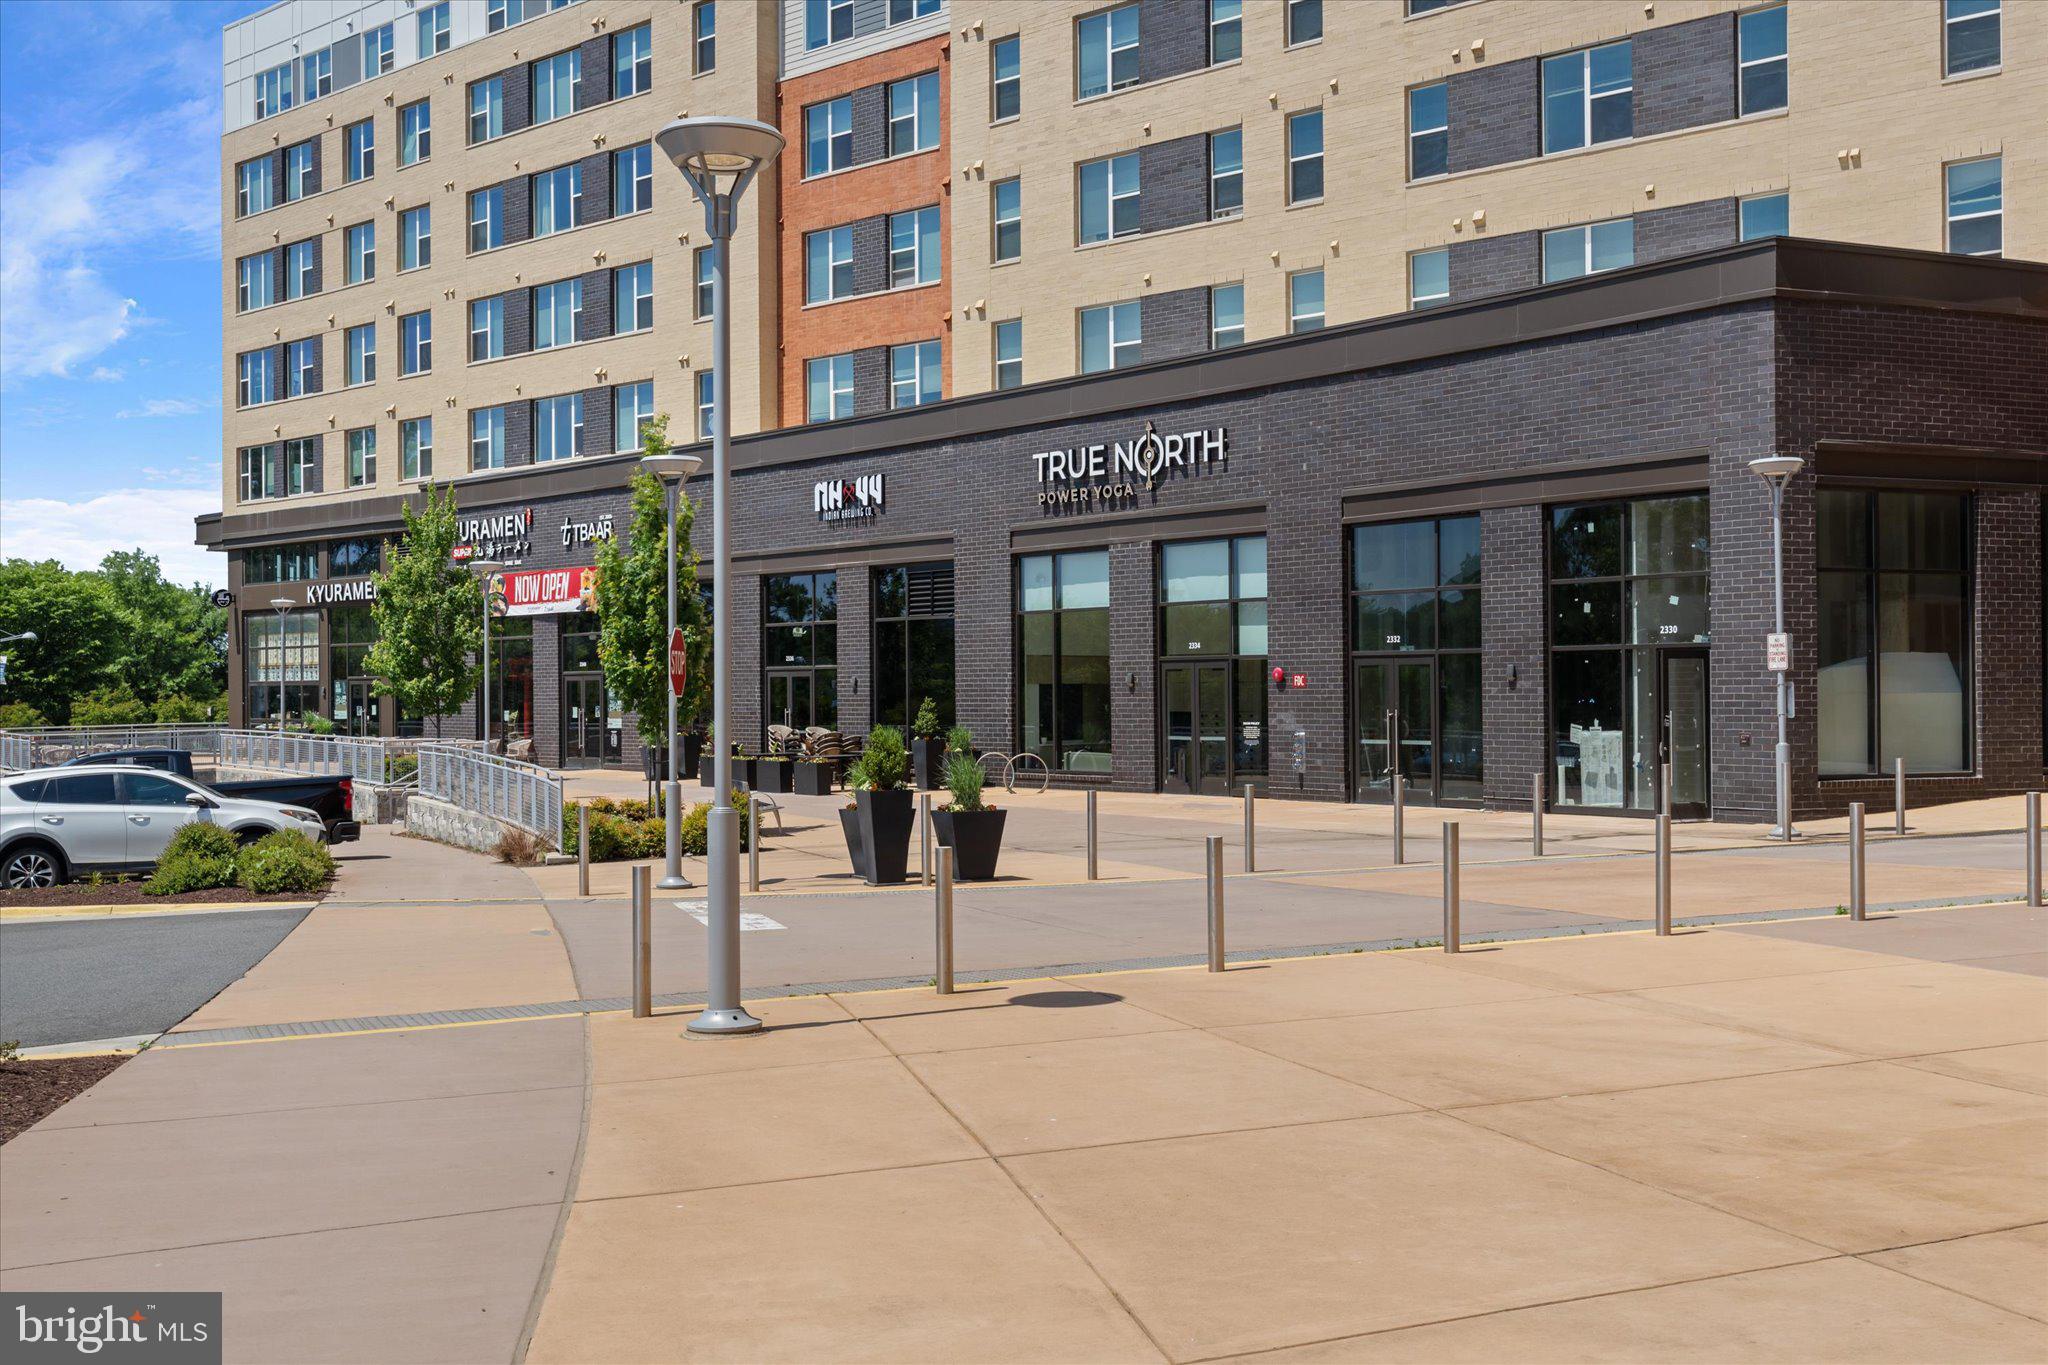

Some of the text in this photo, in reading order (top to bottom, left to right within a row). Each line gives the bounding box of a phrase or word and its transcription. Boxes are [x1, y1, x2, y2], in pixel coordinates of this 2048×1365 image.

[1033, 428, 1224, 482] TRUE NORTH
[1038, 483, 1134, 505] POWER YOGA
[456, 513, 525, 542] URAMEN
[515, 572, 570, 603] NOW OPEN
[1387, 635, 1400, 643] 2332
[1660, 625, 1678, 634] 2330
[671, 650, 684, 675] STOP
